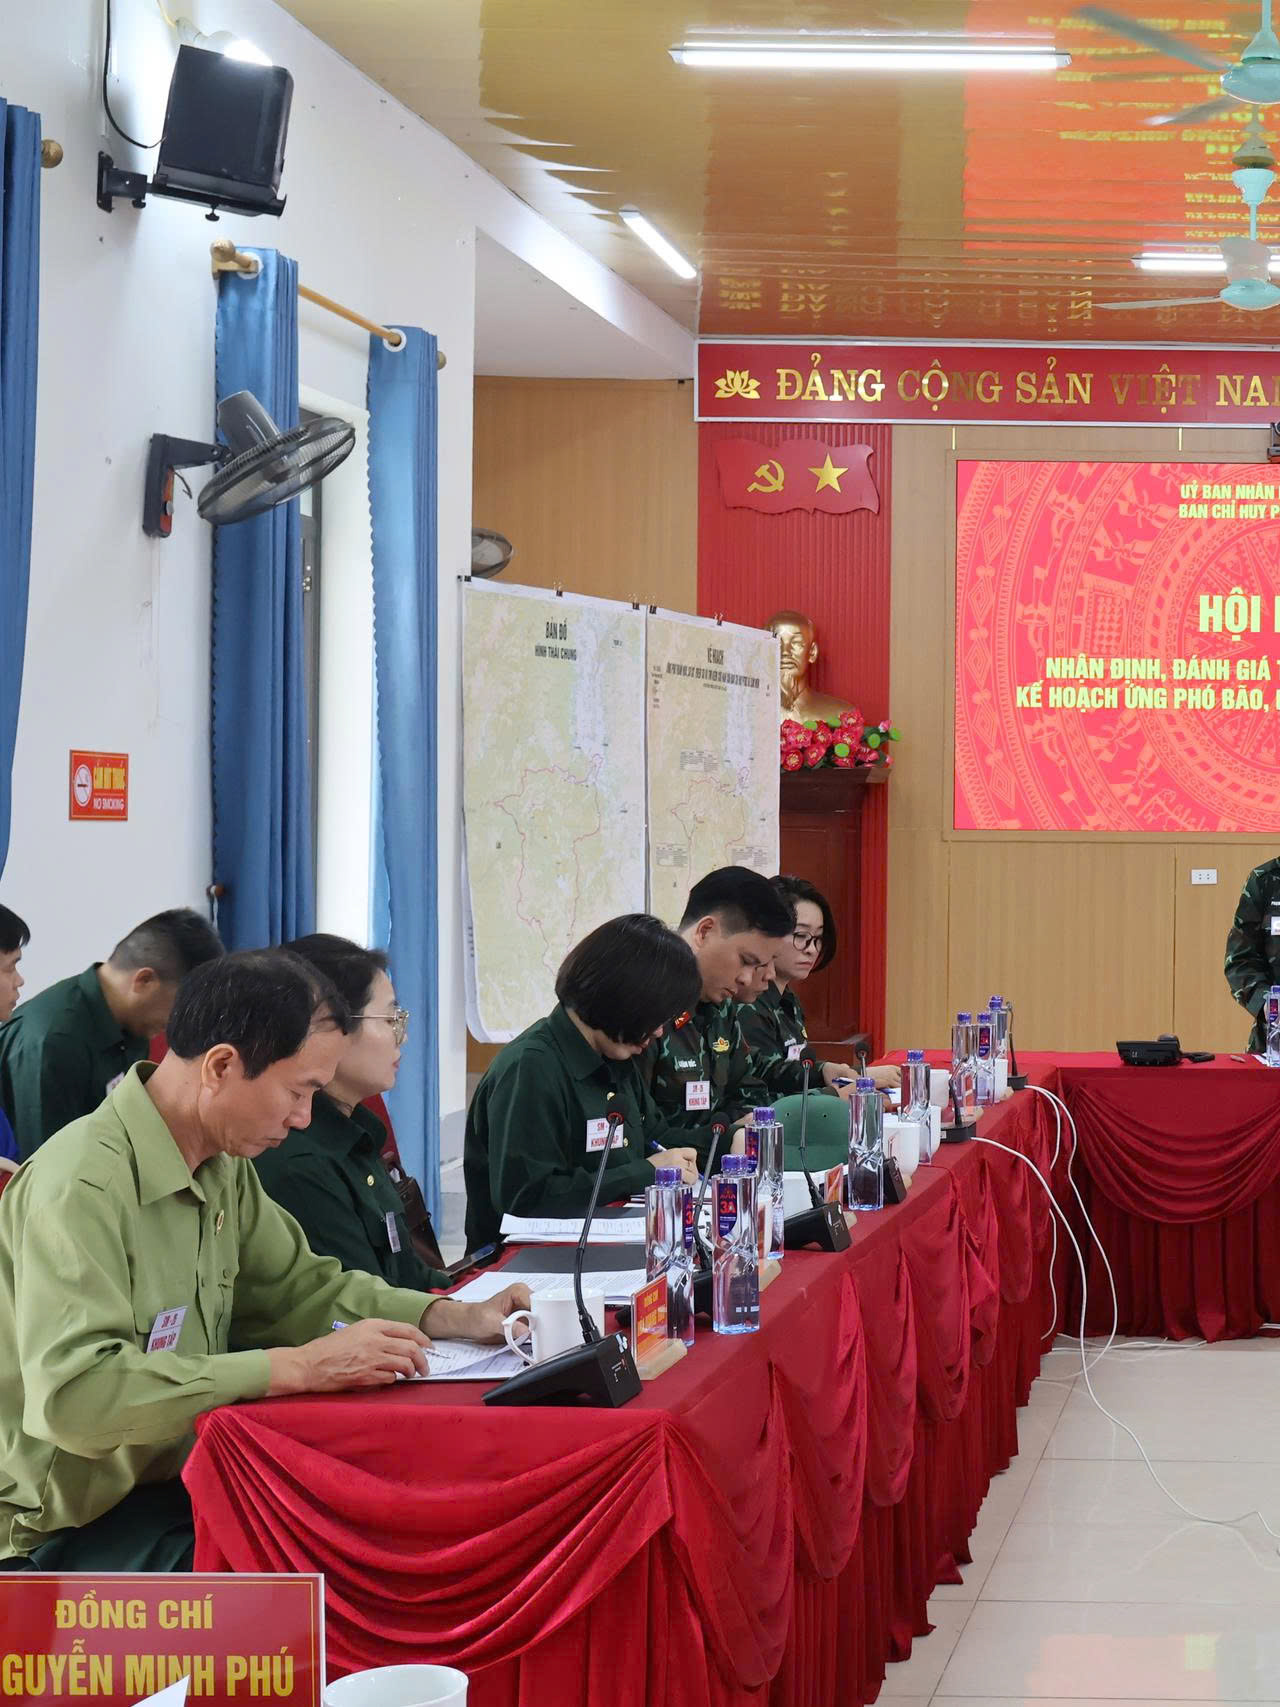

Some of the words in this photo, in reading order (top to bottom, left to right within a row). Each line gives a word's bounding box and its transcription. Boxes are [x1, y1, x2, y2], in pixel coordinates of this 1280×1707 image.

[776, 353, 885, 402] ĐẢNG
[897, 360, 1003, 412] CỘNG
[1016, 356, 1093, 405] SẢN
[1110, 363, 1200, 414] VIỆT
[1202, 484, 1232, 499] BAN
[1235, 482, 1275, 499] NHÂN
[1179, 503, 1208, 518] BAN
[1212, 500, 1235, 519] CHỈ
[1240, 504, 1266, 519] HUY
[1199, 586, 1261, 641] HỘI
[1046, 653, 1104, 683] NHẬN
[1110, 657, 1167, 684] ĐỊNH,
[1172, 655, 1230, 681] ĐÁNH
[1236, 655, 1271, 681] GIÁ
[1016, 679, 1045, 708] KẾ
[1050, 686, 1118, 713] HOẠCH
[1124, 682, 1168, 709] ỨNG
[1174, 684, 1216, 709] PHÓ
[1221, 685, 1269, 712] BÃO,
[720, 1201, 736, 1213] 3A
[55, 1590, 146, 1630] ĐỒNG
[158, 1593, 213, 1629] CHÍ
[2, 1638, 112, 1696] GUYỄN
[124, 1654, 215, 1696] MINH
[227, 1646, 294, 1697] PHÚ
